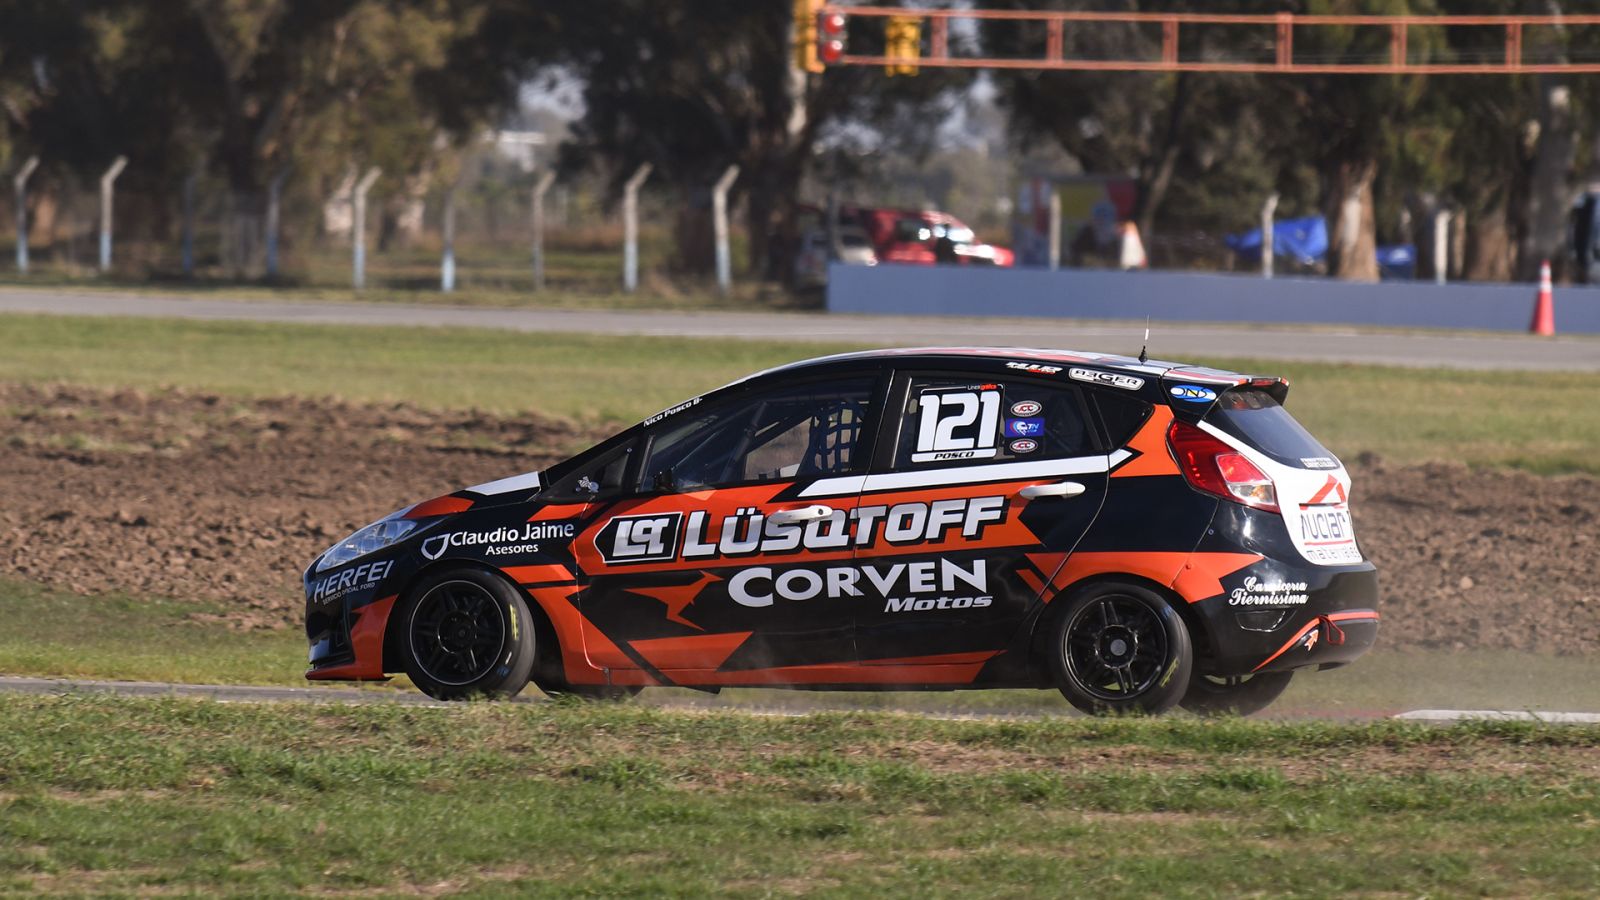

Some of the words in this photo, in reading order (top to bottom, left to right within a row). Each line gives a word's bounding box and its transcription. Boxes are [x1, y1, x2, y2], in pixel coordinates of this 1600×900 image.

[643, 414, 663, 427] Nico
[664, 401, 692, 417] Posco
[916, 391, 1000, 452] 121
[934, 451, 975, 460] POSCO
[450, 526, 518, 547] Claudio
[520, 522, 575, 541] Jaime
[485, 543, 539, 556] Asesores
[314, 559, 394, 603] HERFEI
[727, 557, 988, 608] CORVEN
[884, 595, 993, 613] Motos
[1229, 587, 1310, 606] Tiernissima
